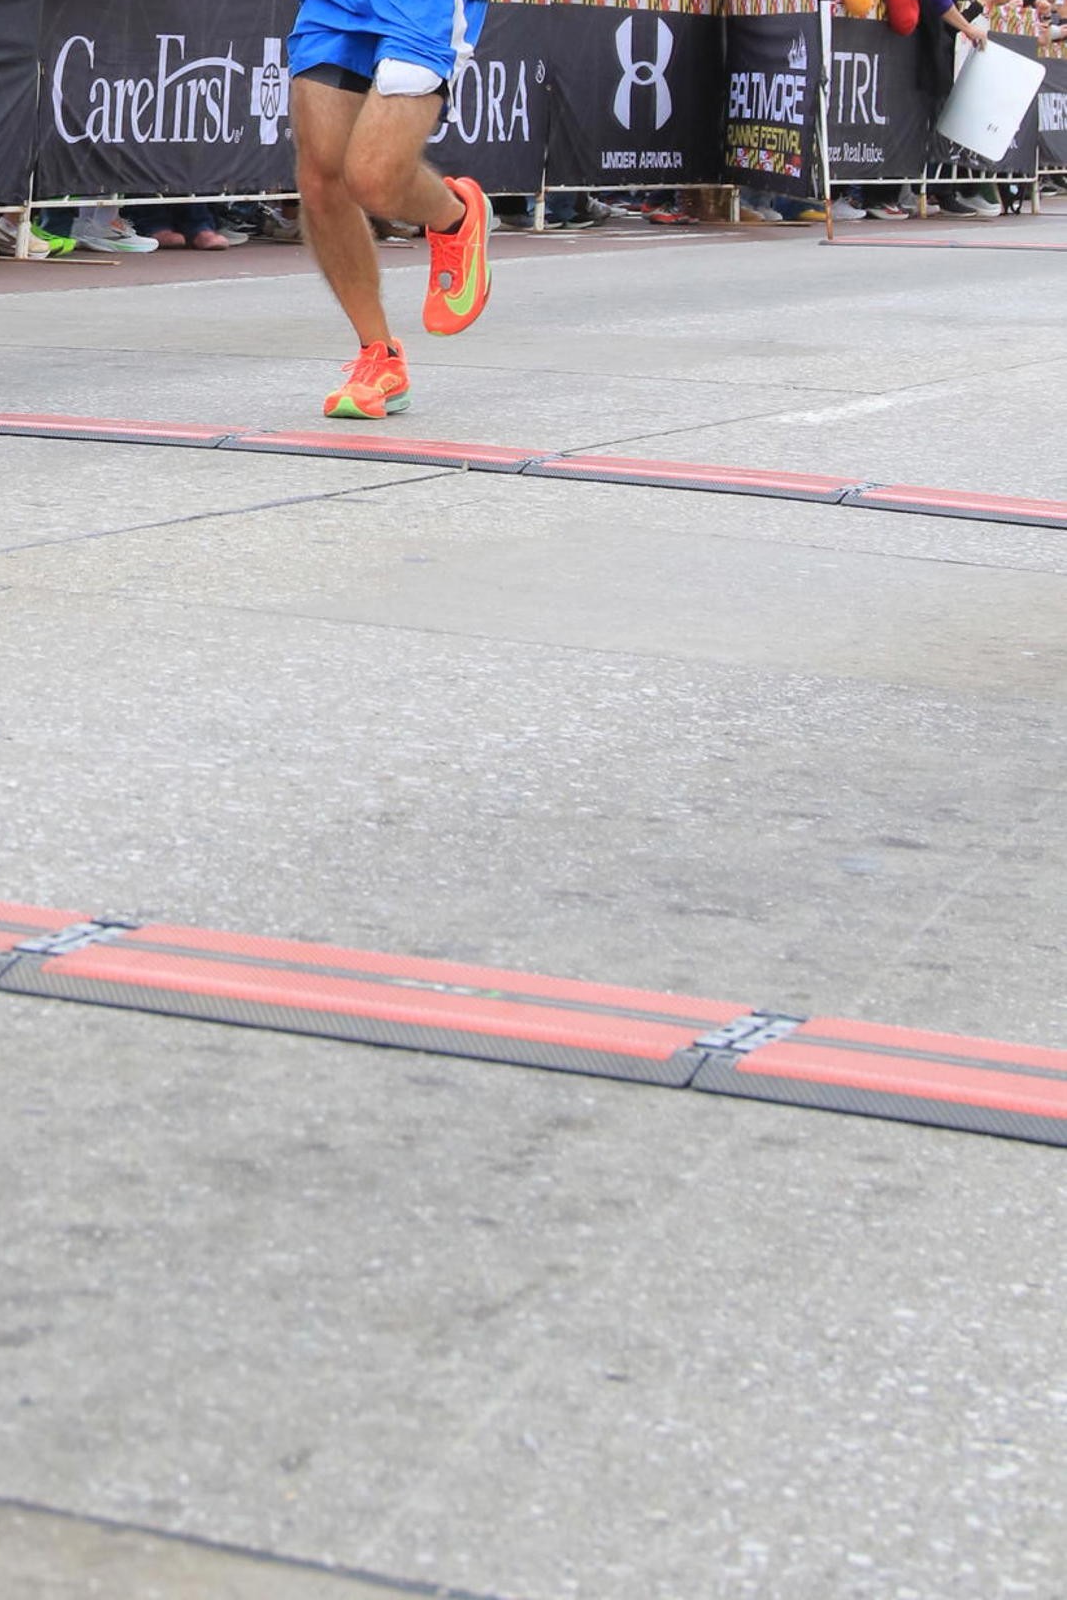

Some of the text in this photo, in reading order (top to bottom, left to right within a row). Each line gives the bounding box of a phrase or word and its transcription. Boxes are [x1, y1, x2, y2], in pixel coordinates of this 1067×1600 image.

[52, 34, 245, 144] CareFirst
[728, 72, 806, 125] BALTIMORE
[760, 126, 802, 155] FESTIVAL
[843, 142, 860, 163] Real
[601, 151, 683, 169] UNDER ARMOUR
